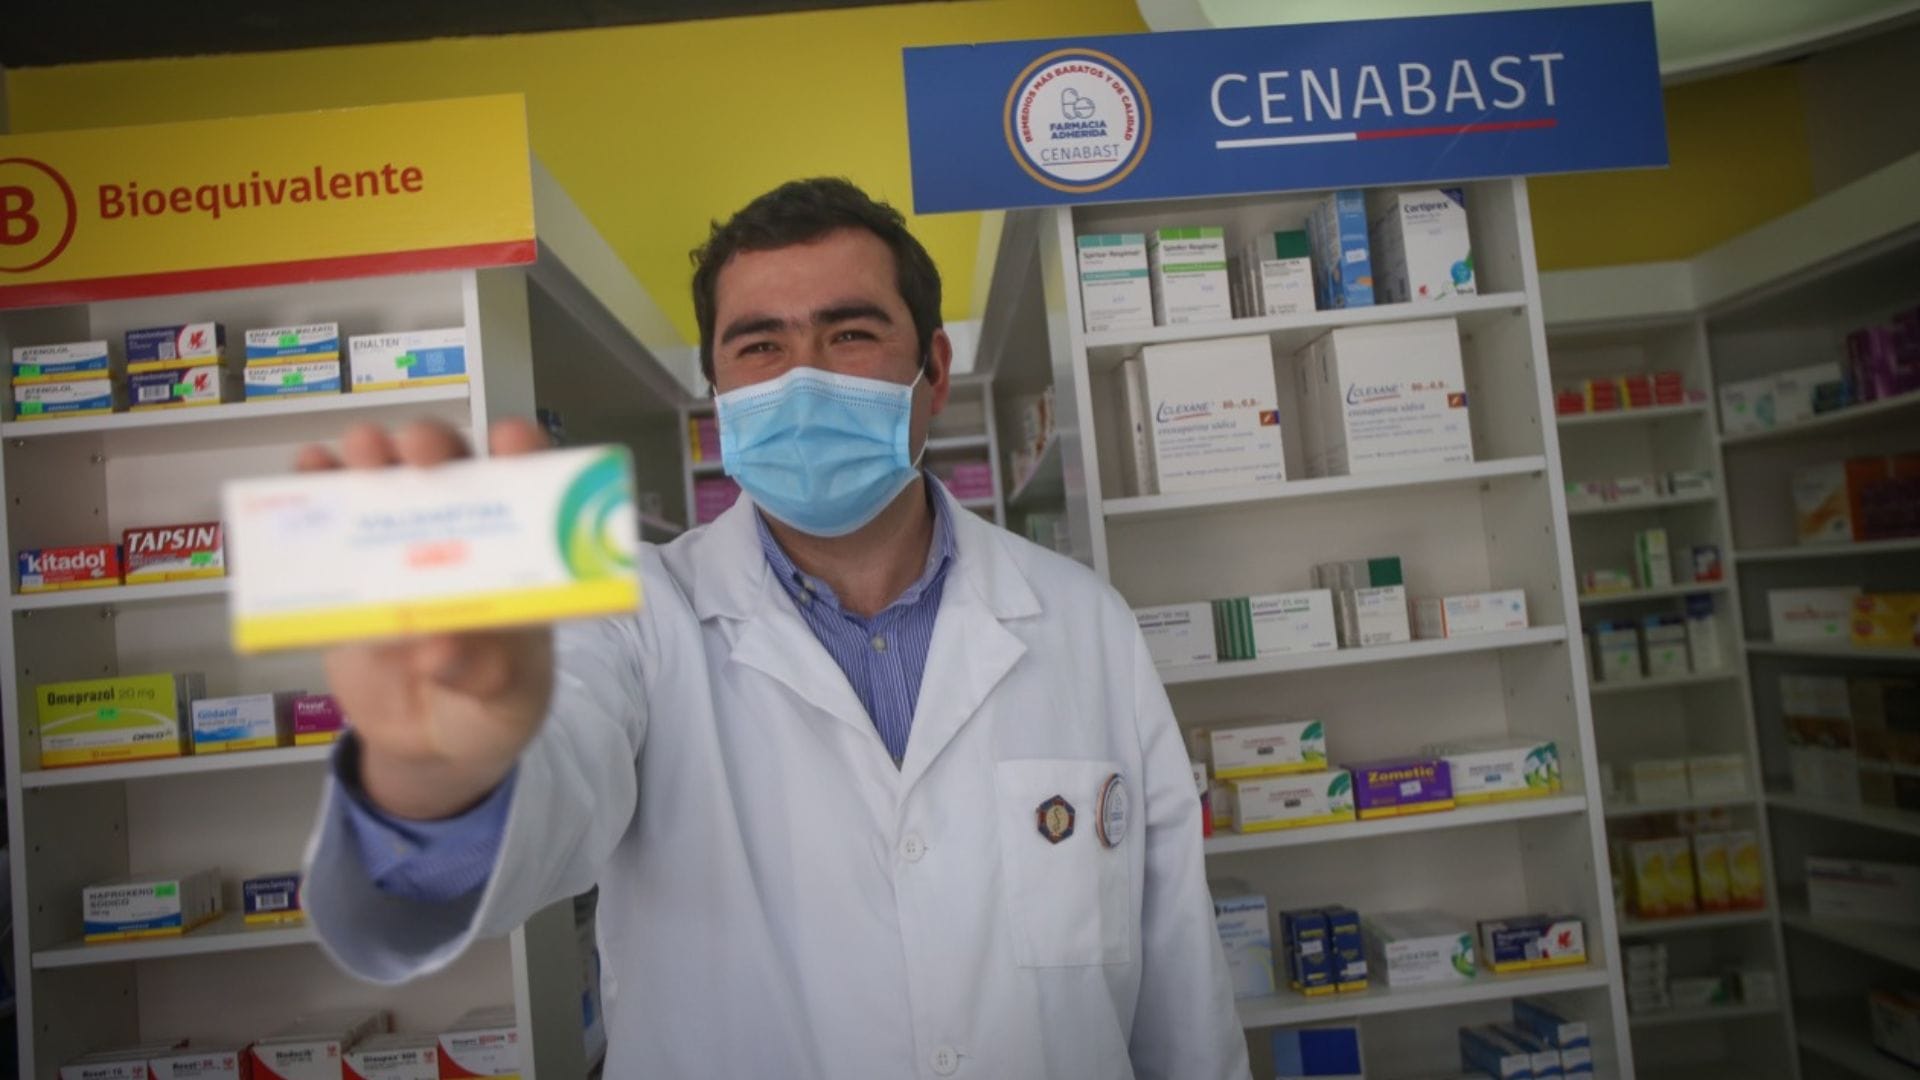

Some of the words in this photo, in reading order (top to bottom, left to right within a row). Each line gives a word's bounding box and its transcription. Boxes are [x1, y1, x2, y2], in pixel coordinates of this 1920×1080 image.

[1211, 53, 1564, 127] CENABAST
[1021, 90, 1037, 143] REMEDIOS
[1054, 65, 1104, 78] BARATOS
[1105, 75, 1113, 83] Y
[1111, 82, 1124, 95] DE
[1121, 95, 1135, 141] CALIDAD
[1050, 120, 1107, 131] FARMACIA
[1051, 130, 1107, 140] ADHERIDA
[1040, 144, 1120, 161] CENABAST
[99, 163, 423, 220] Bioequivalente
[0, 185, 39, 246] B
[127, 525, 215, 553] TAPSIN
[28, 549, 106, 573] kitadol
[47, 687, 115, 707] Omeprazol
[1368, 765, 1434, 784] Zometic
